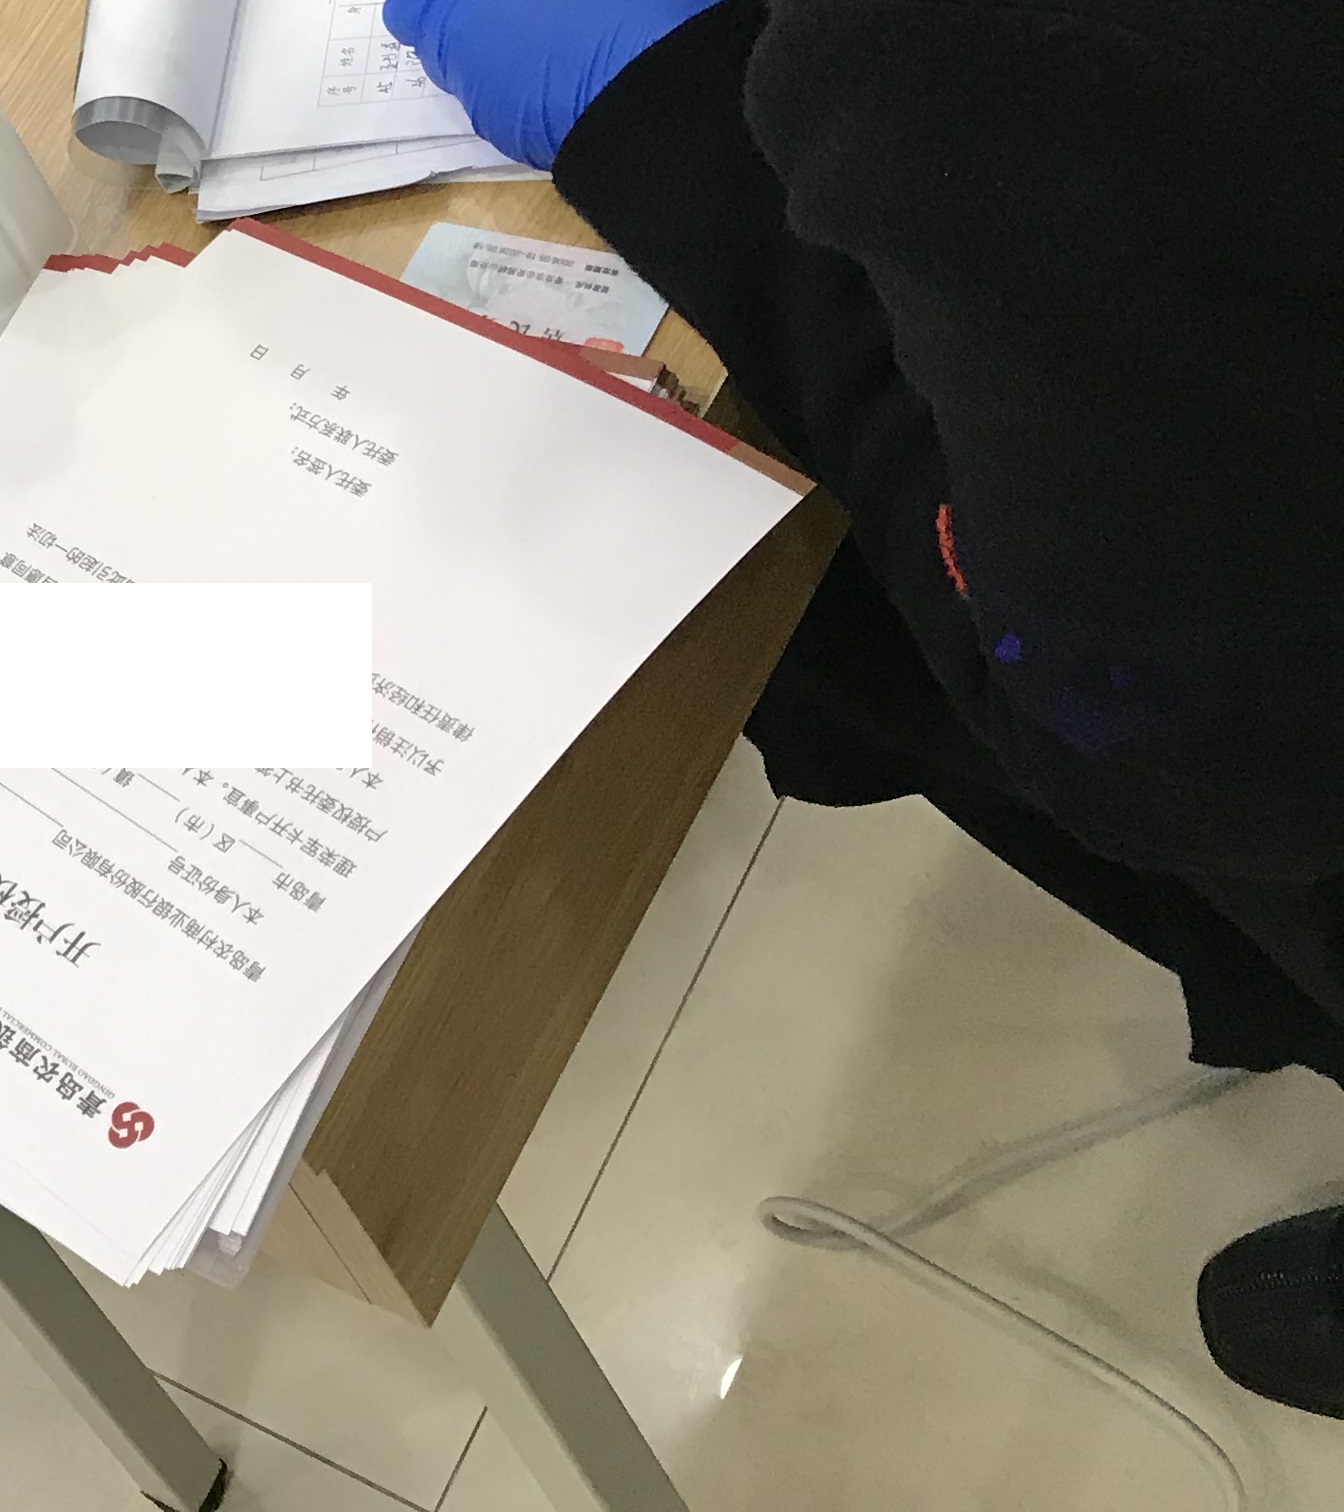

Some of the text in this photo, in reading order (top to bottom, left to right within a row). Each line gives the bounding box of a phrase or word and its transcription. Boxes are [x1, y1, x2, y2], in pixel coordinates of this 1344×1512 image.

[249, 341, 352, 402] 年 月 日
[284, 400, 398, 469] 委托人联系方式：
[286, 444, 371, 500] 委托人签名：
[50, 826, 267, 984] 青岛农村商业银行股份有限公司
[165, 851, 266, 927] 本人身份证号
[271, 867, 327, 914] 青岛市
